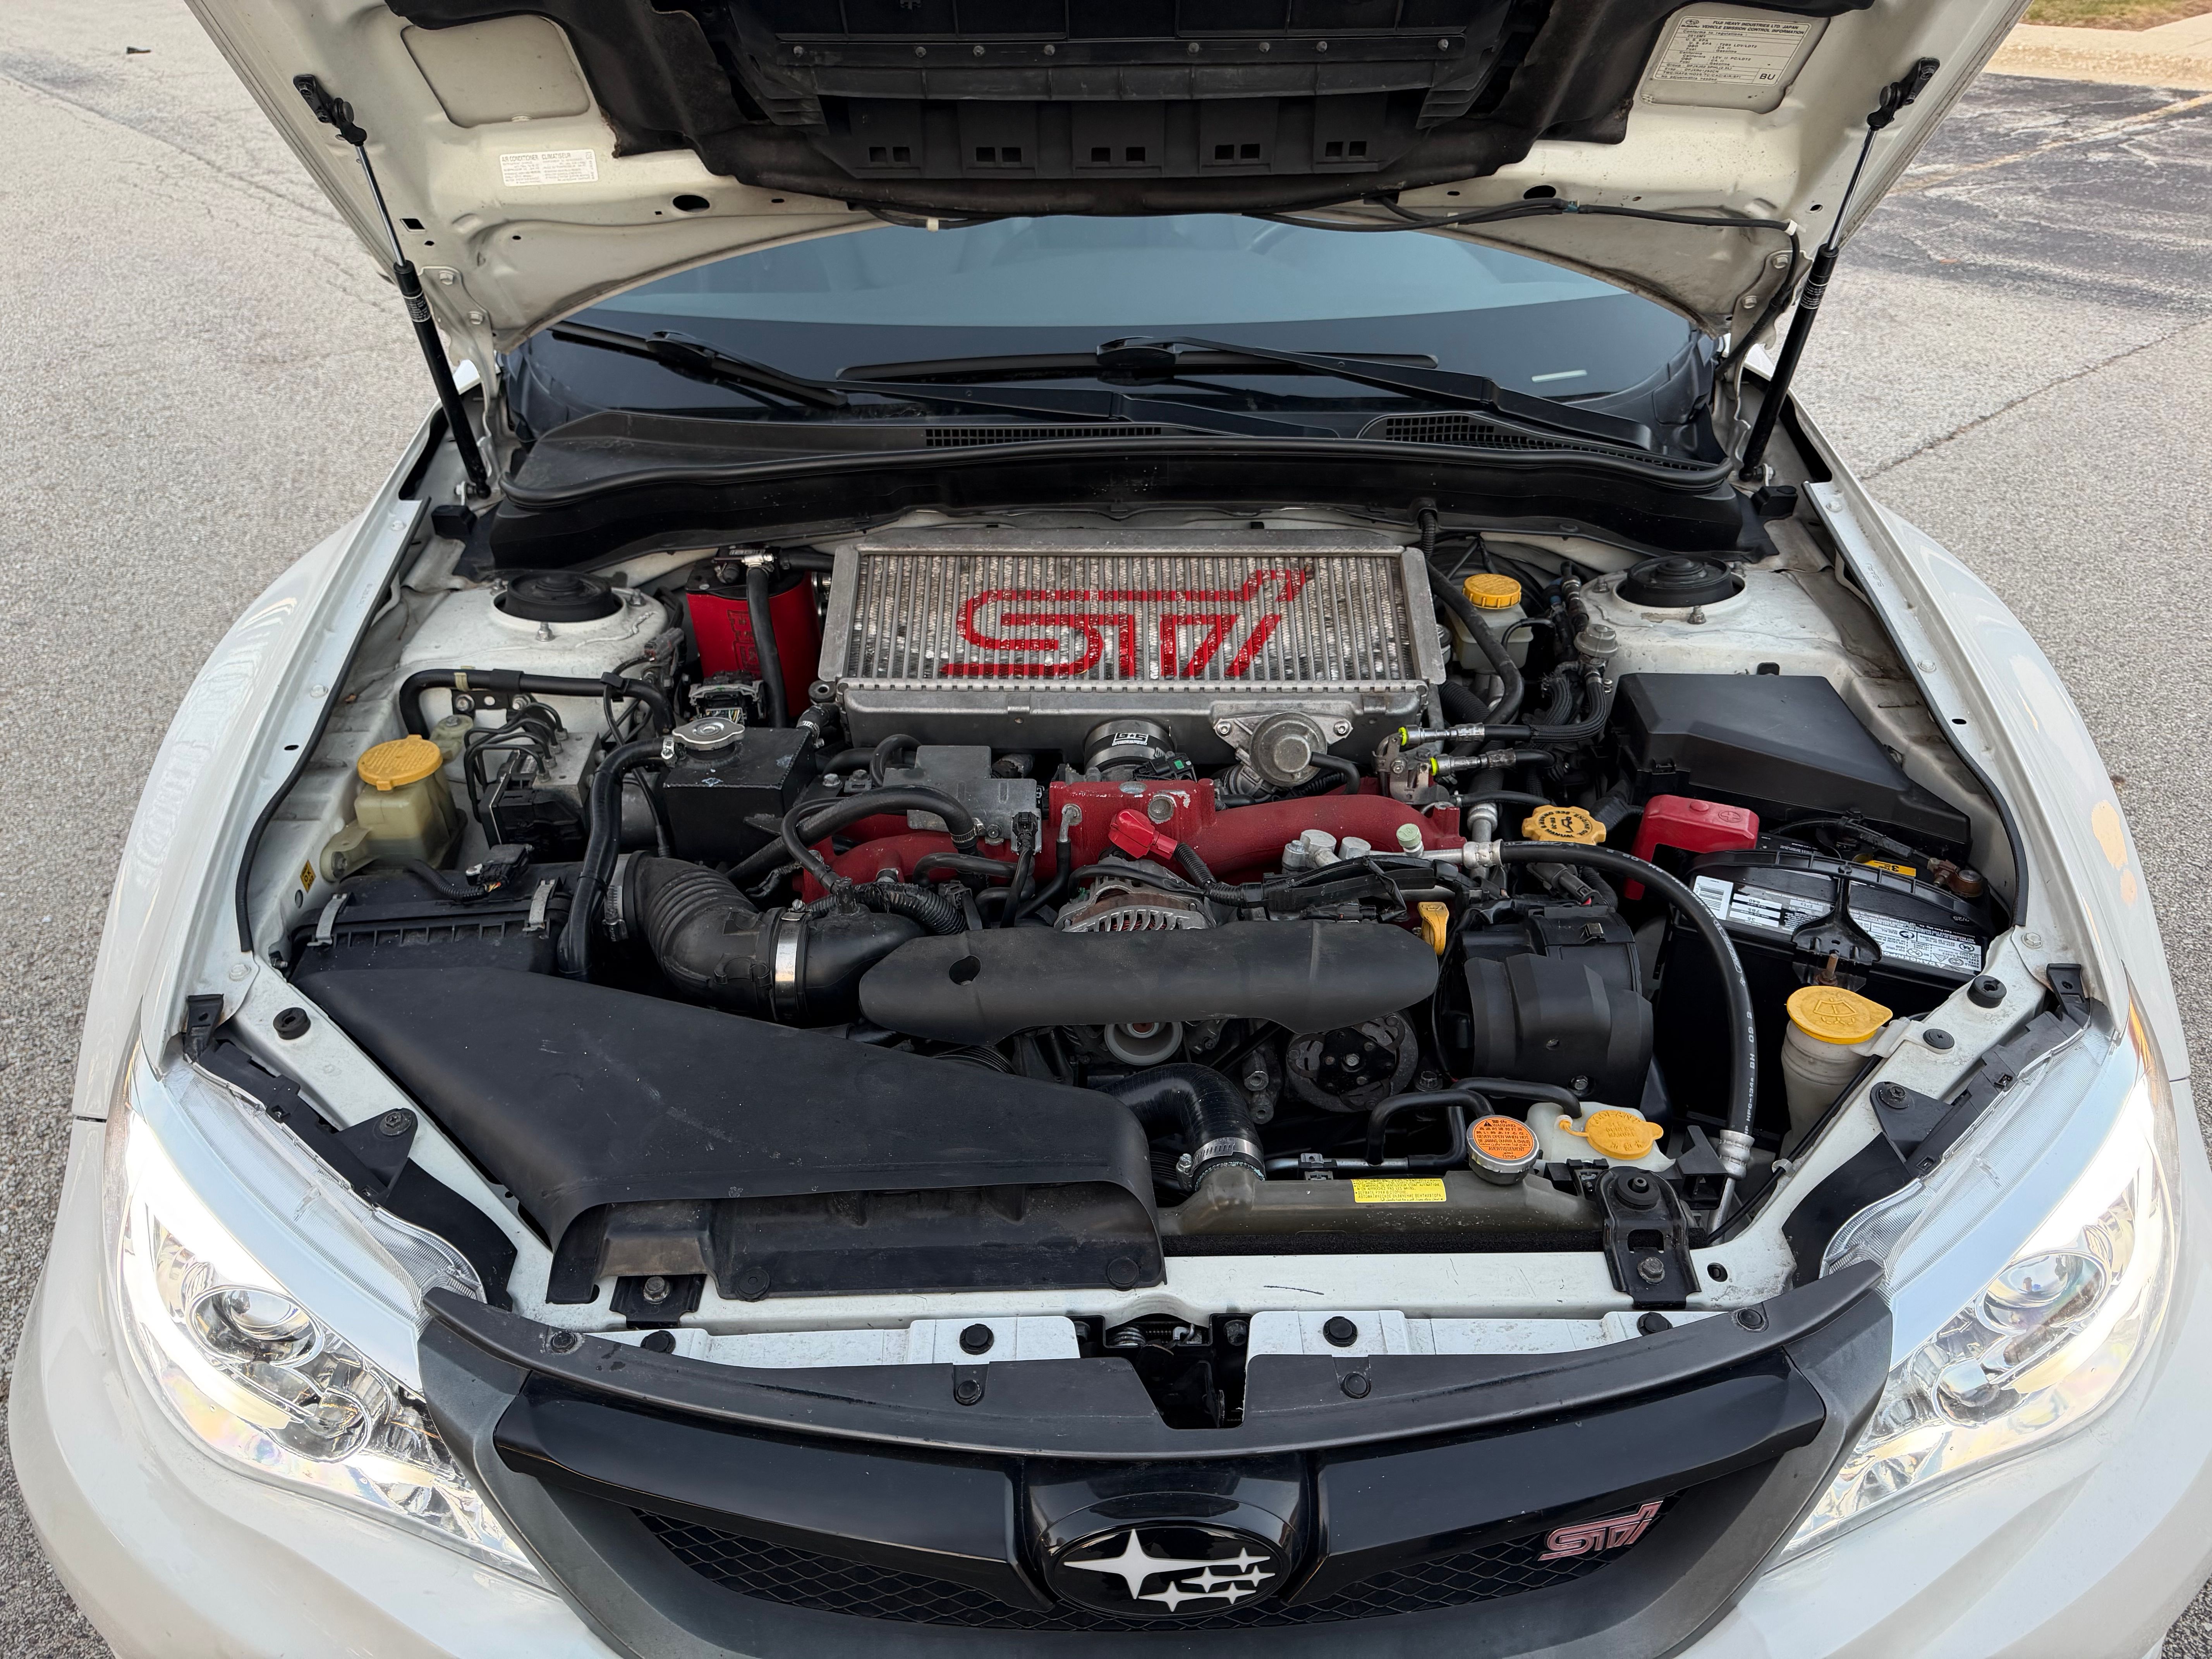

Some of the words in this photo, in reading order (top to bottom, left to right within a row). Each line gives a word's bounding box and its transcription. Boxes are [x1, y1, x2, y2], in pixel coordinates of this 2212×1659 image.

[1573, 813, 1590, 830] ENGINE
[1544, 829, 1575, 838] MANUAL
[1747, 1011, 1753, 1019] 2
[1748, 1027, 1754, 1043] 09
